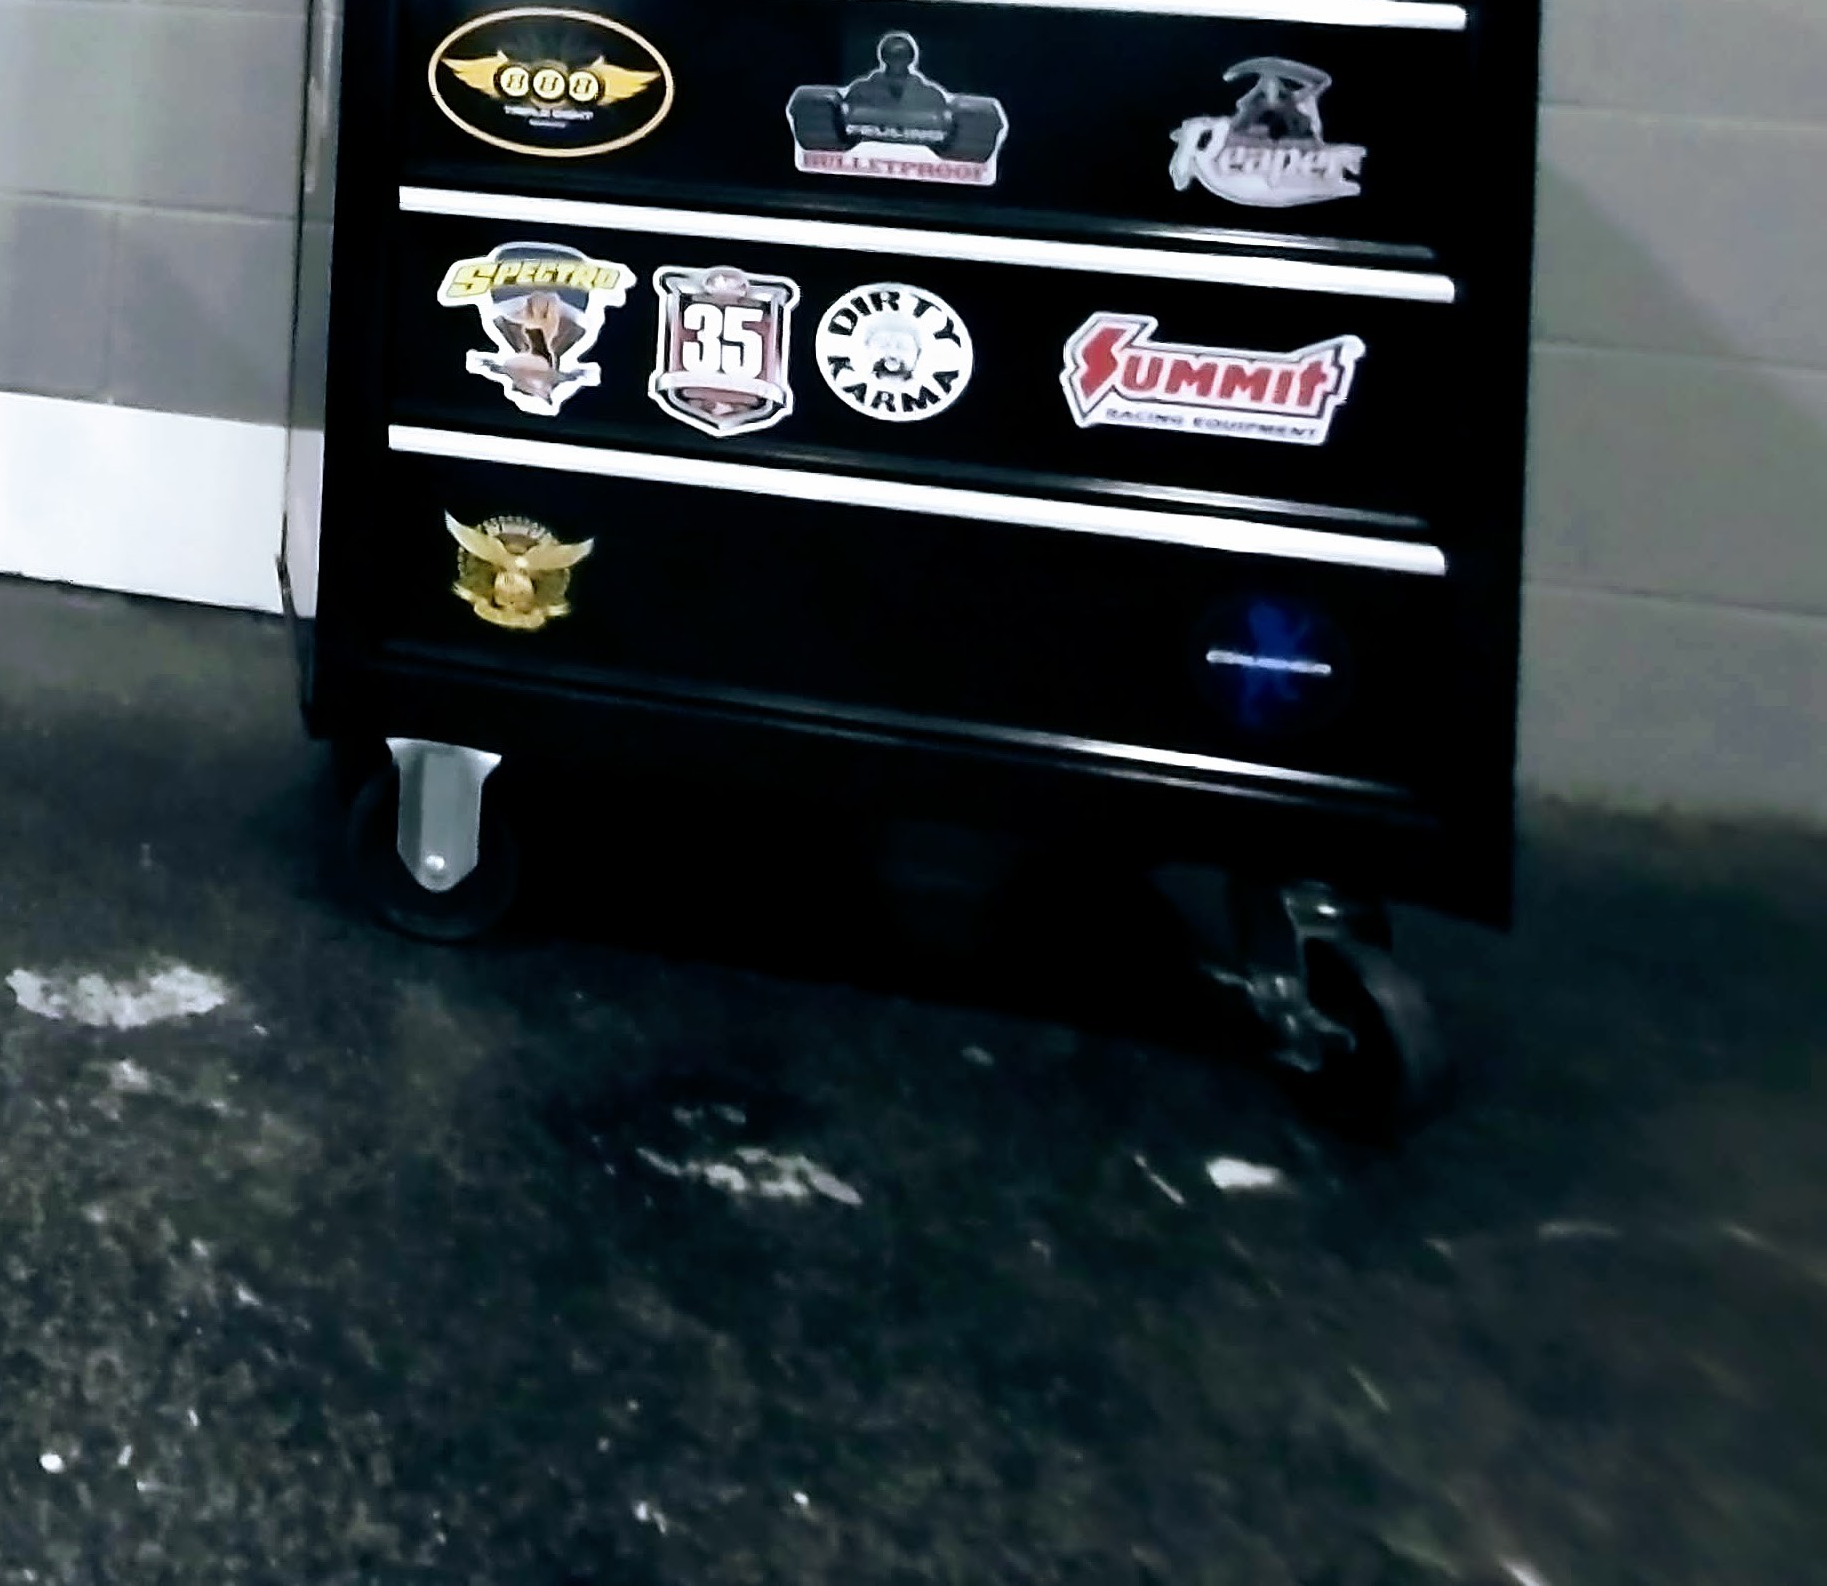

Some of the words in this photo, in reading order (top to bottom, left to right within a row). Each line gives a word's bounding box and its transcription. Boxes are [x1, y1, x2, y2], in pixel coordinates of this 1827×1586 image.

[445, 260, 622, 299] SPECTRO
[682, 303, 764, 379] 35
[827, 290, 962, 349] DIRTY
[826, 354, 960, 413] KARMA
